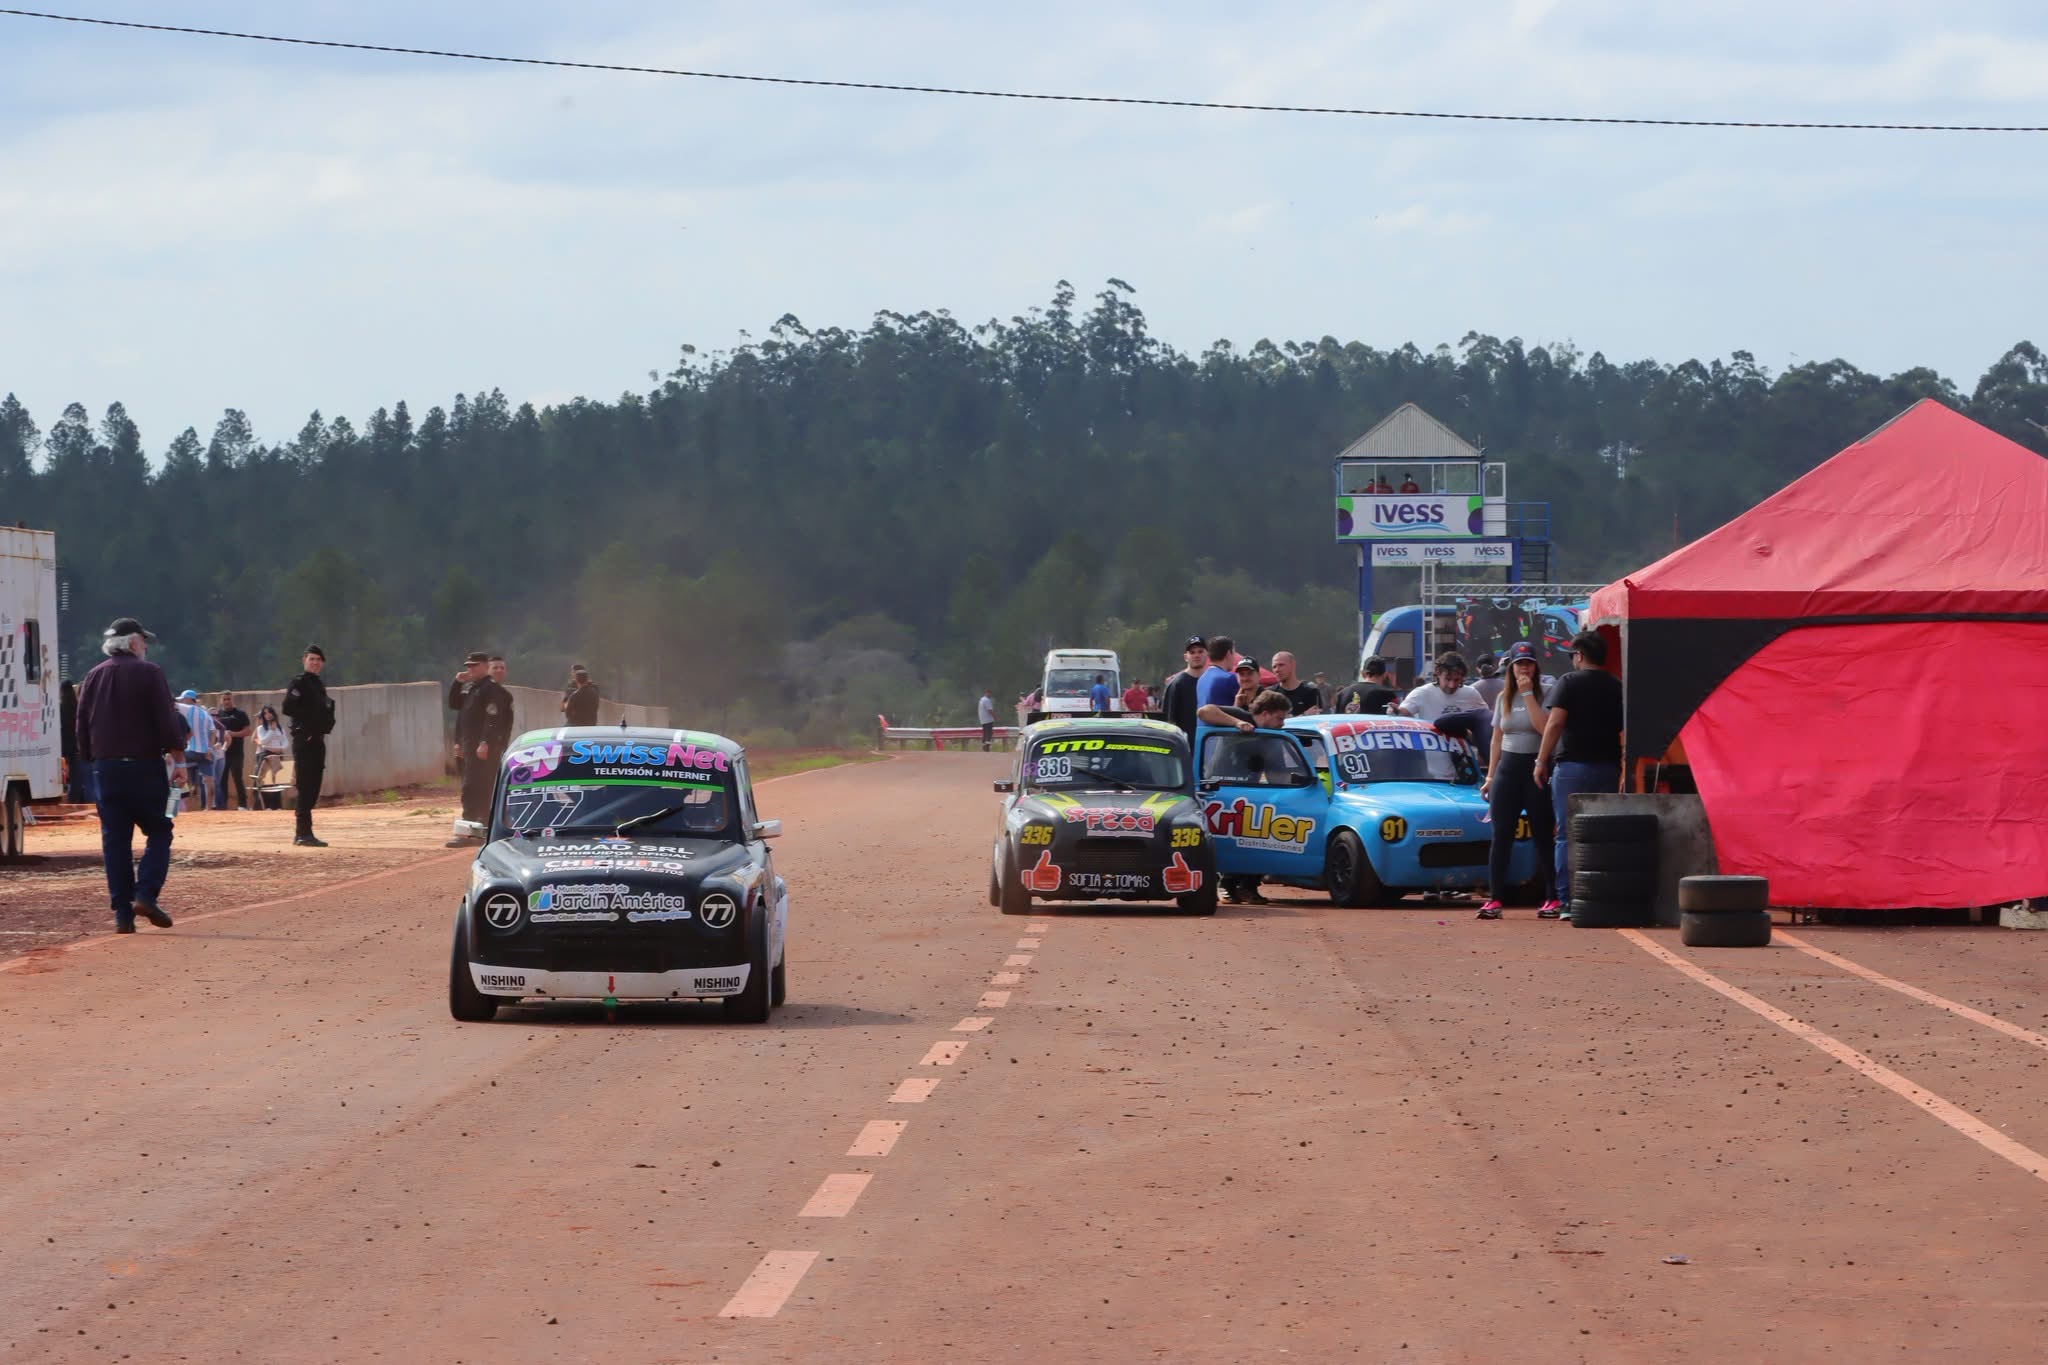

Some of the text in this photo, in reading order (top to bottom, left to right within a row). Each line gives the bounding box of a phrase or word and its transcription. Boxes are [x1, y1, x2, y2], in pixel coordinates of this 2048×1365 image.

[1040, 740, 1105, 754] TITO
[1335, 733, 1413, 753] BUEN
[568, 740, 729, 772] SwissNet
[1343, 753, 1371, 774] 91
[594, 766, 653, 777] TELEVISIÓN
[662, 770, 712, 781] INTERNET
[1038, 756, 1071, 777] 336
[507, 791, 584, 829] 77
[1020, 826, 1053, 845] 336
[1170, 828, 1201, 847] 336
[1383, 819, 1404, 840] 91
[639, 845, 694, 854] SRL
[1069, 873, 1101, 887] SOFIA
[1115, 874, 1151, 888] TOMAS
[558, 885, 628, 894] Municipalidad de
[552, 892, 684, 909] Jardín América
[488, 904, 517, 919] 77
[704, 904, 733, 919] 77
[481, 975, 525, 986] NISHINO
[694, 976, 740, 988] NISHINO
